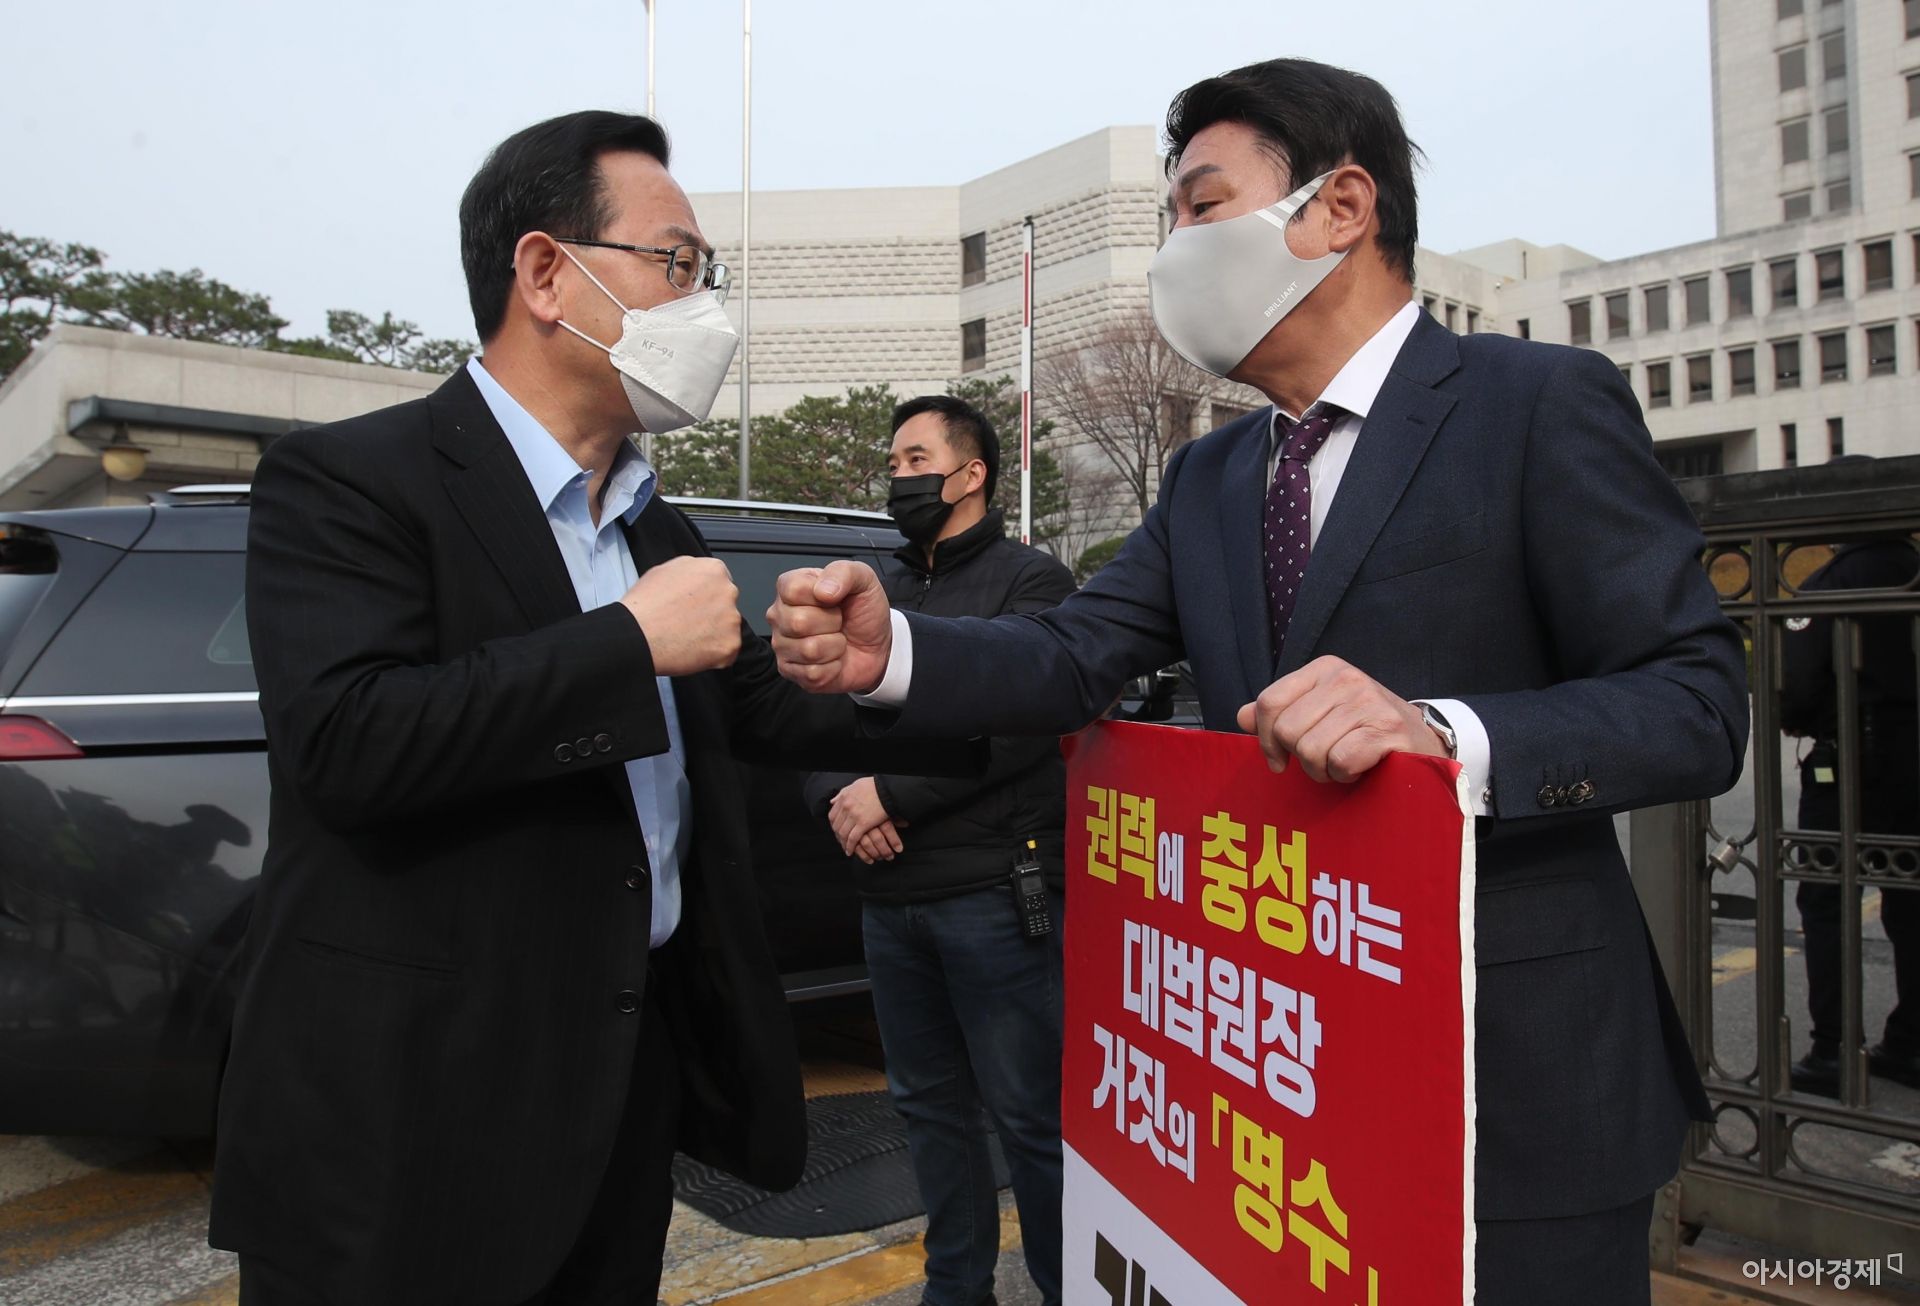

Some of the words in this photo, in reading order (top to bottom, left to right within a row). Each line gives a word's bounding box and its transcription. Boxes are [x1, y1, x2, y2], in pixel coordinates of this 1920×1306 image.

[641, 338, 674, 358] KF-94
[1264, 281, 1298, 317] BRILLIANT
[1086, 785, 1184, 904] 권력에
[1200, 810, 1403, 985] 충성하는
[1123, 918, 1323, 1118] 대법원장
[1092, 1022, 1196, 1184] 거짓의
